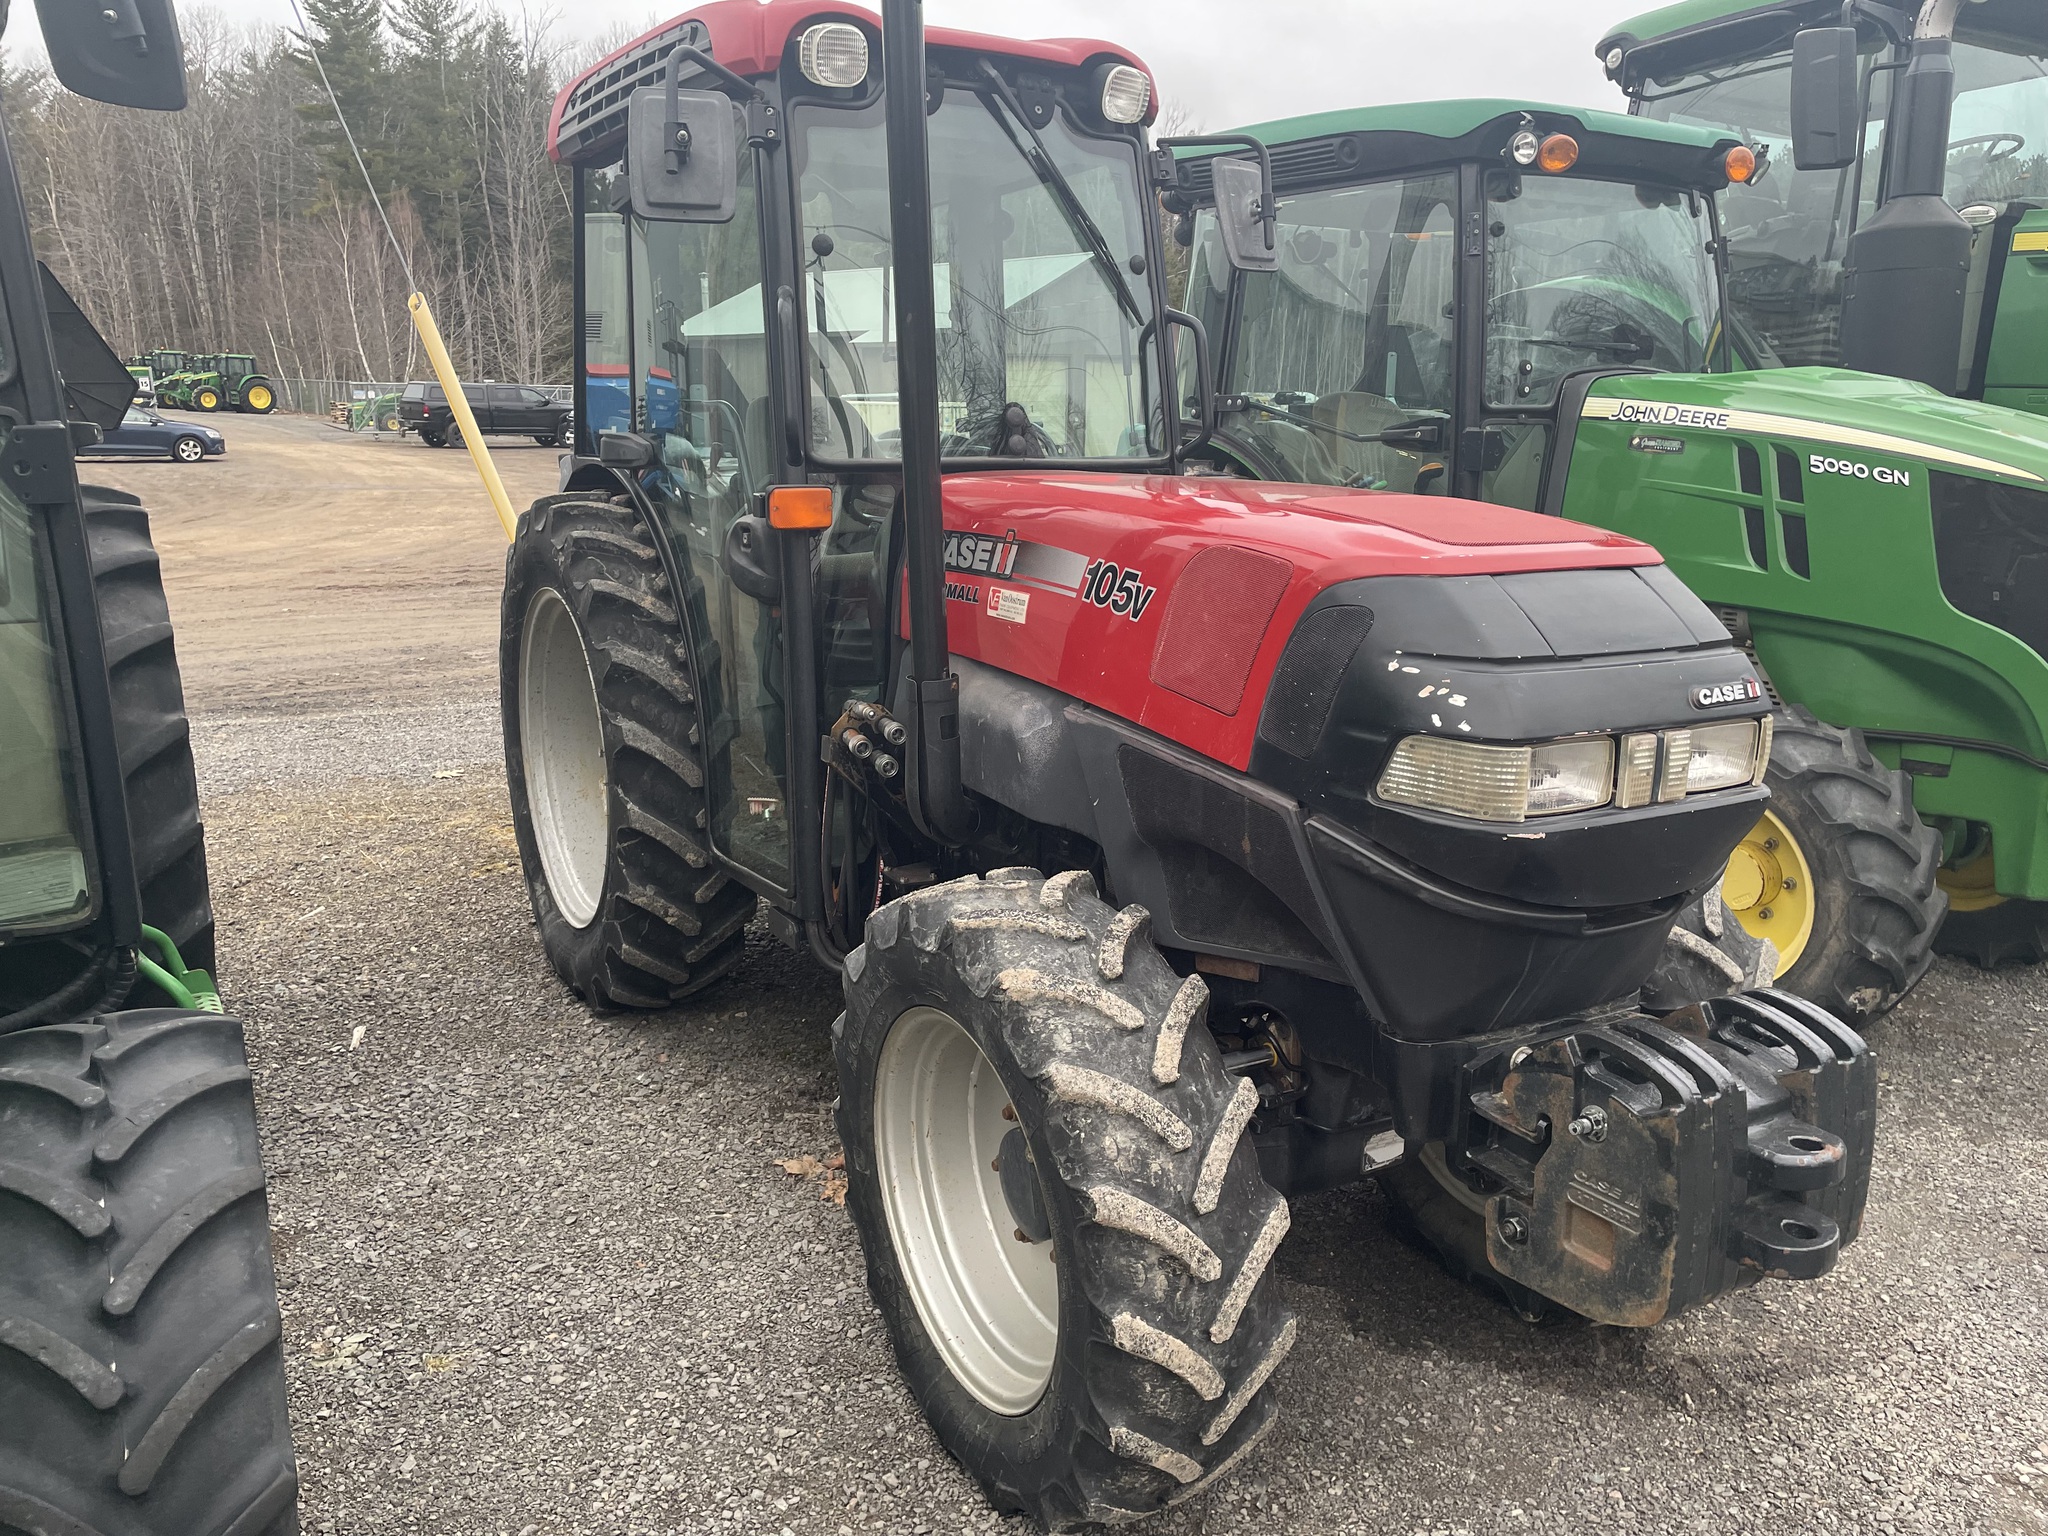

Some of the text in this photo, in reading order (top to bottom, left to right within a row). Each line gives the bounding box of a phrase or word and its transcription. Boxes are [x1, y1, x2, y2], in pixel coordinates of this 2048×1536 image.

[1610, 401, 1730, 428] JOHN DEERE
[1809, 454, 1910, 487] 5090 GN
[943, 537, 994, 571] ASE
[945, 582, 980, 604] MALL
[1082, 558, 1157, 622] 105V
[1698, 684, 1746, 705] CASE
[1573, 1169, 1622, 1200] CASE
